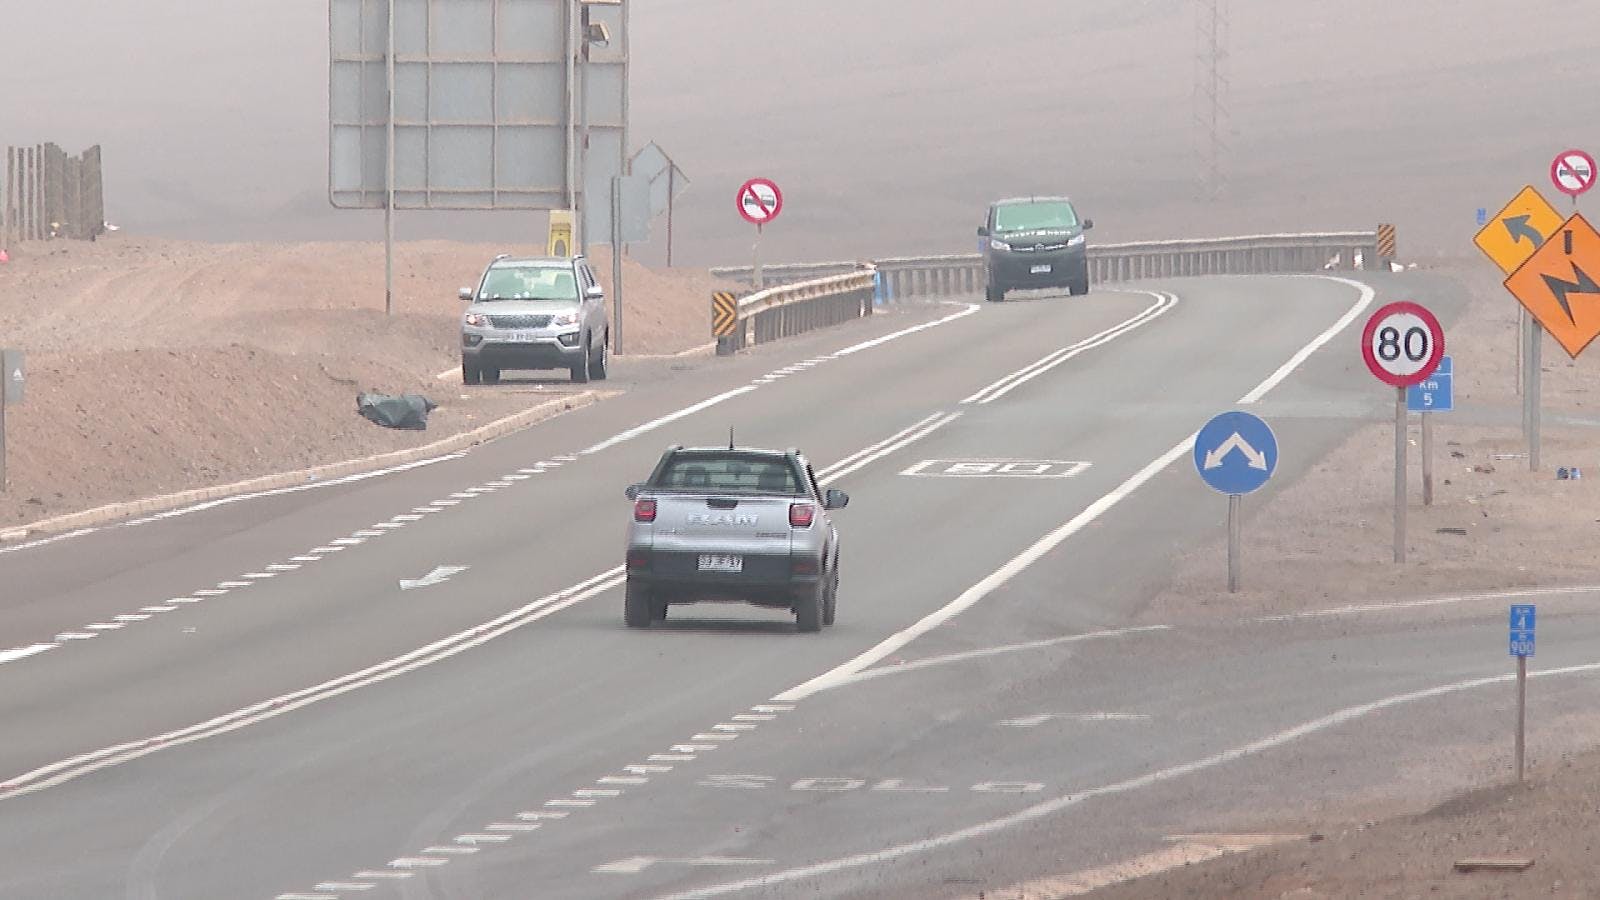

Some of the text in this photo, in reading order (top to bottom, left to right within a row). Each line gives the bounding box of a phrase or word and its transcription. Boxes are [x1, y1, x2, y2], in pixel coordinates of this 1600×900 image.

[1378, 326, 1428, 362] 80
[1423, 392, 1433, 406] 5
[686, 512, 760, 526] RAM
[1517, 615, 1526, 630] 4
[1511, 641, 1536, 655] 900
